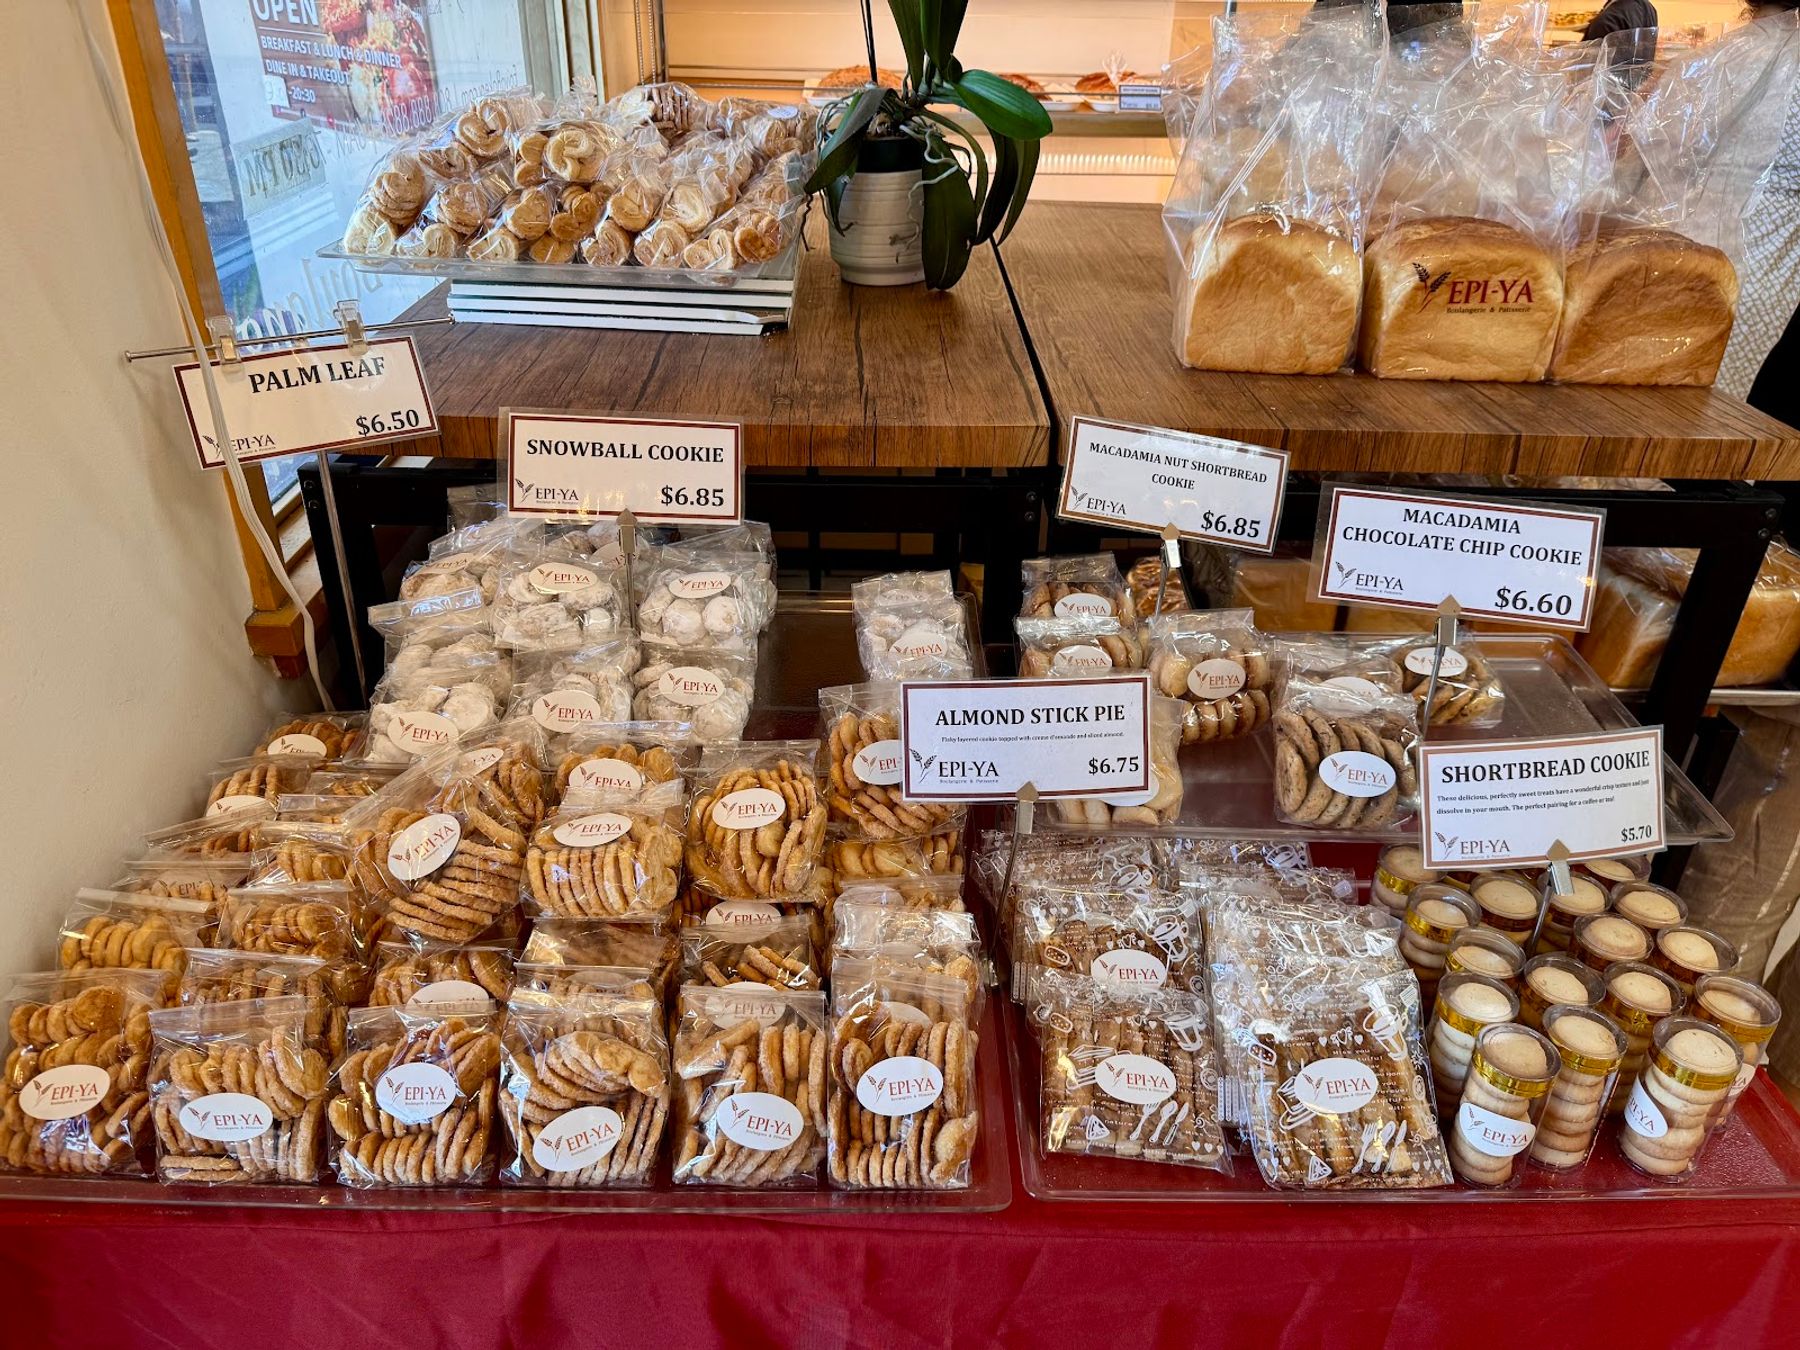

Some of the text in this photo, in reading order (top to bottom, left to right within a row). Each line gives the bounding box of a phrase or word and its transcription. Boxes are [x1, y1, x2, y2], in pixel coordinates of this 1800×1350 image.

[253, 0, 319, 26] OPEN
[260, 35, 403, 70] BREAKFAST & LUNCH & DINNER
[265, 59, 351, 87] DINE IN & TAKEOUT
[1448, 279, 1534, 305] EPI-YA
[248, 356, 385, 393] PALM LEAF
[355, 409, 420, 437] $6.50
[527, 439, 724, 463] SNOWBALL COOKIE
[1089, 442, 1268, 483] MACADAMIA NUT SHORTBREAD
[1151, 473, 1196, 490] COOKIE
[536, 488, 579, 501] EPI-YA
[660, 484, 725, 508] $6.85
[1087, 497, 1127, 515] EPI-YA
[1201, 510, 1261, 538] $6.85
[1403, 508, 1521, 534] MACADAMIA
[1343, 526, 1583, 566] CHOCOLATE CHIP COOKIE
[554, 572, 591, 583] EPI-YA
[1355, 573, 1404, 591] EPI-YA
[1494, 586, 1573, 616] $6.60
[683, 680, 719, 694] EPI-YA
[1208, 674, 1241, 686] EPI-YA
[557, 707, 594, 720] EPI-YA
[935, 704, 1125, 726] ALMOND STICK PIE
[998, 735, 1018, 743] topped
[879, 757, 900, 771] EPI-
[938, 760, 1000, 778] EPI-YA
[1088, 755, 1139, 776] $6.75
[1441, 750, 1651, 784] SHORTBREAD COOKIE
[595, 775, 632, 789] EPI-YA
[1347, 768, 1388, 786] EPI-YA
[1458, 794, 1488, 802] delicious,
[1489, 792, 1517, 801] perfectly
[1574, 785, 1602, 793] wonderful
[1602, 783, 1615, 791] crisp
[737, 802, 777, 815] EPI-YA
[1436, 807, 1464, 815] dissolve
[1472, 806, 1487, 815] your
[1525, 803, 1546, 811] perfect
[1547, 801, 1569, 809] pairing
[581, 823, 623, 833] EPI-YA
[1620, 825, 1652, 843] $5.70
[413, 825, 455, 861] EPI-YA
[1460, 839, 1511, 855] EPI-YA
[1118, 968, 1158, 980] EPI-YA
[888, 1077, 936, 1096] EPI-YA
[1125, 1071, 1169, 1089] EPI-YA
[1326, 1077, 1371, 1095] EPI-YA
[51, 1083, 98, 1101] EPI-YA
[405, 1086, 447, 1101] EPI-YA
[213, 1113, 264, 1127] EPI-YA
[1629, 1096, 1655, 1131] PI-YA
[747, 1115, 793, 1137] EPI-YA
[566, 1121, 615, 1152] EPI-YA
[1482, 1127, 1528, 1145] EPI-YA
